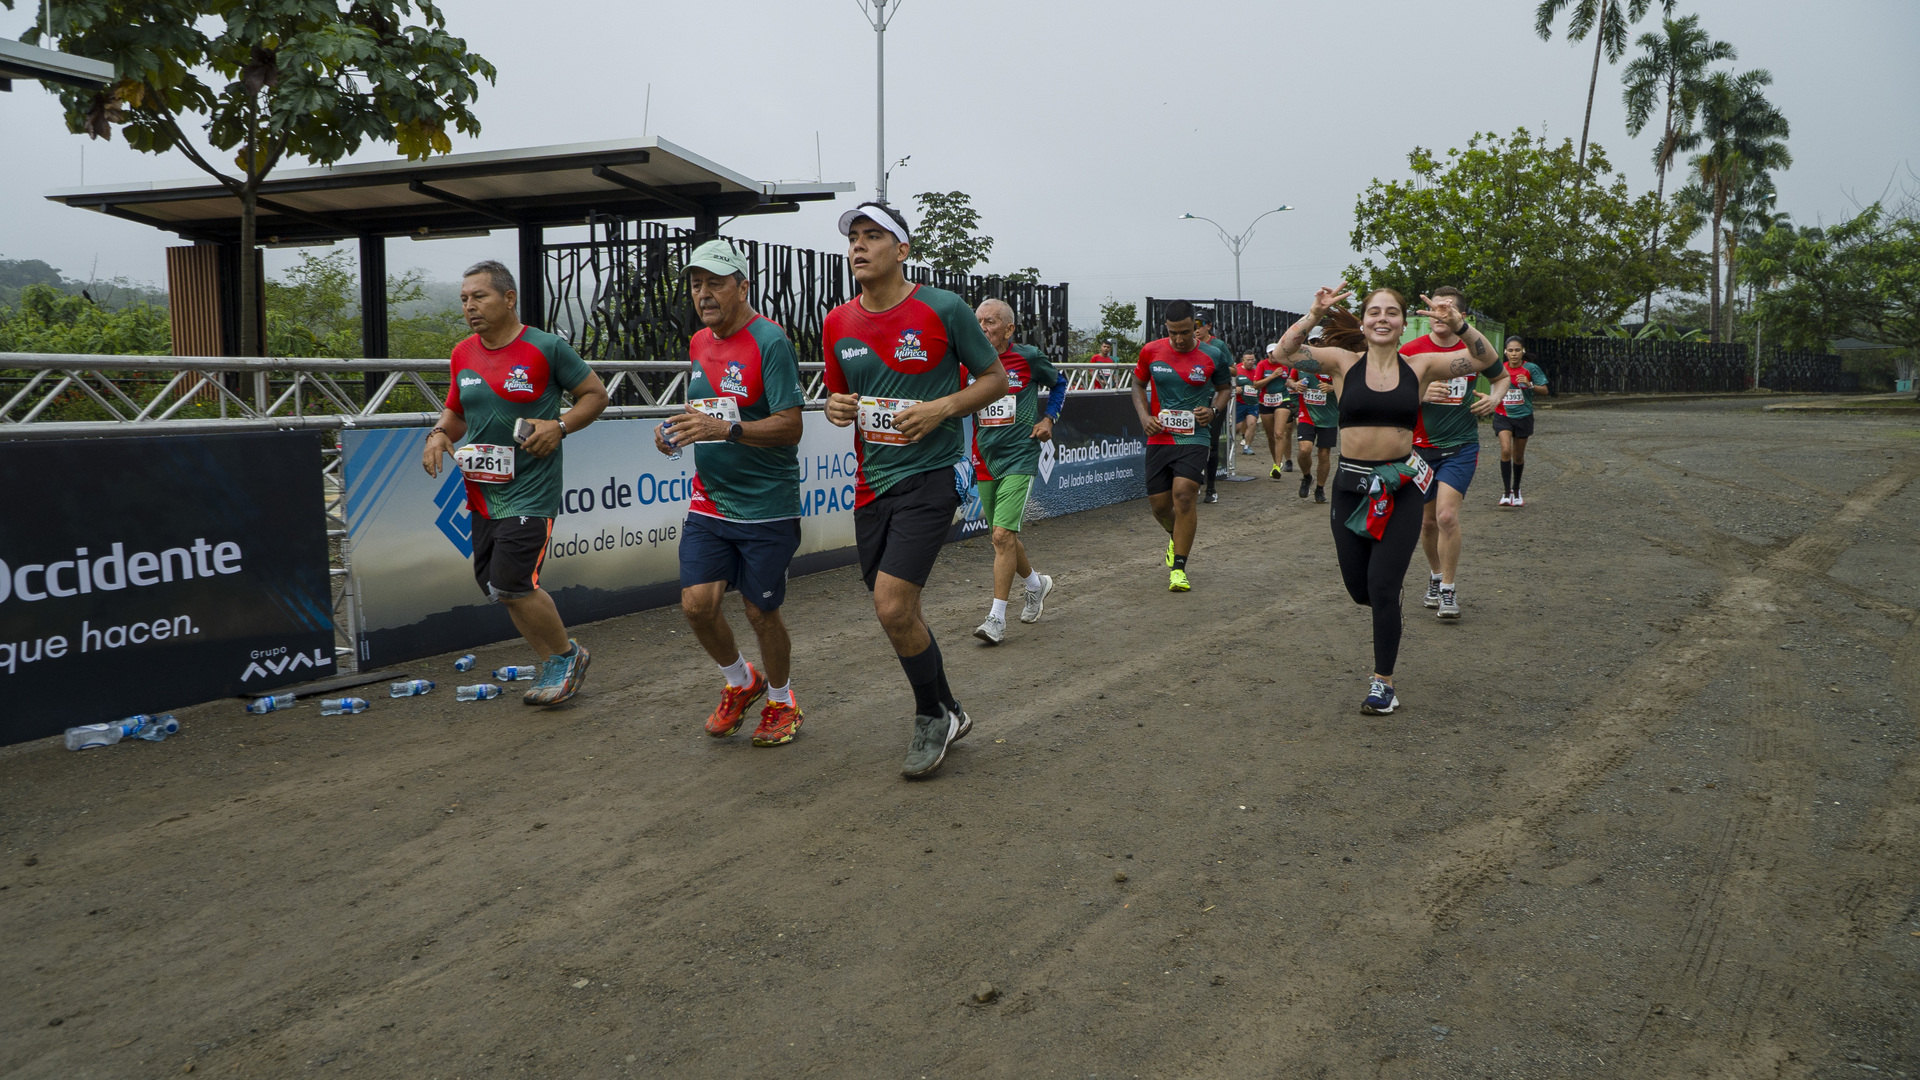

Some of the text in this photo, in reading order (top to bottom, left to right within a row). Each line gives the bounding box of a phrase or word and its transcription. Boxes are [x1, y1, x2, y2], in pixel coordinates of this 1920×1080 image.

[713, 254, 730, 262] 2XU
[984, 405, 1004, 417] 185
[872, 412, 898, 431] 36
[1164, 417, 1189, 427] 1386
[1058, 437, 1142, 465] Banco de Occidente
[465, 456, 502, 472] 1261
[1058, 474, 1070, 489] Del
[1085, 470, 1093, 484] de
[1094, 470, 1103, 482] los
[1104, 471, 1115, 484] que
[602, 476, 632, 510] de
[962, 519, 988, 533] AVAL
[548, 525, 677, 560] lado de los que
[81, 614, 200, 653] hacen.
[250, 646, 287, 660] Grupo
[240, 648, 332, 683] AVAL
